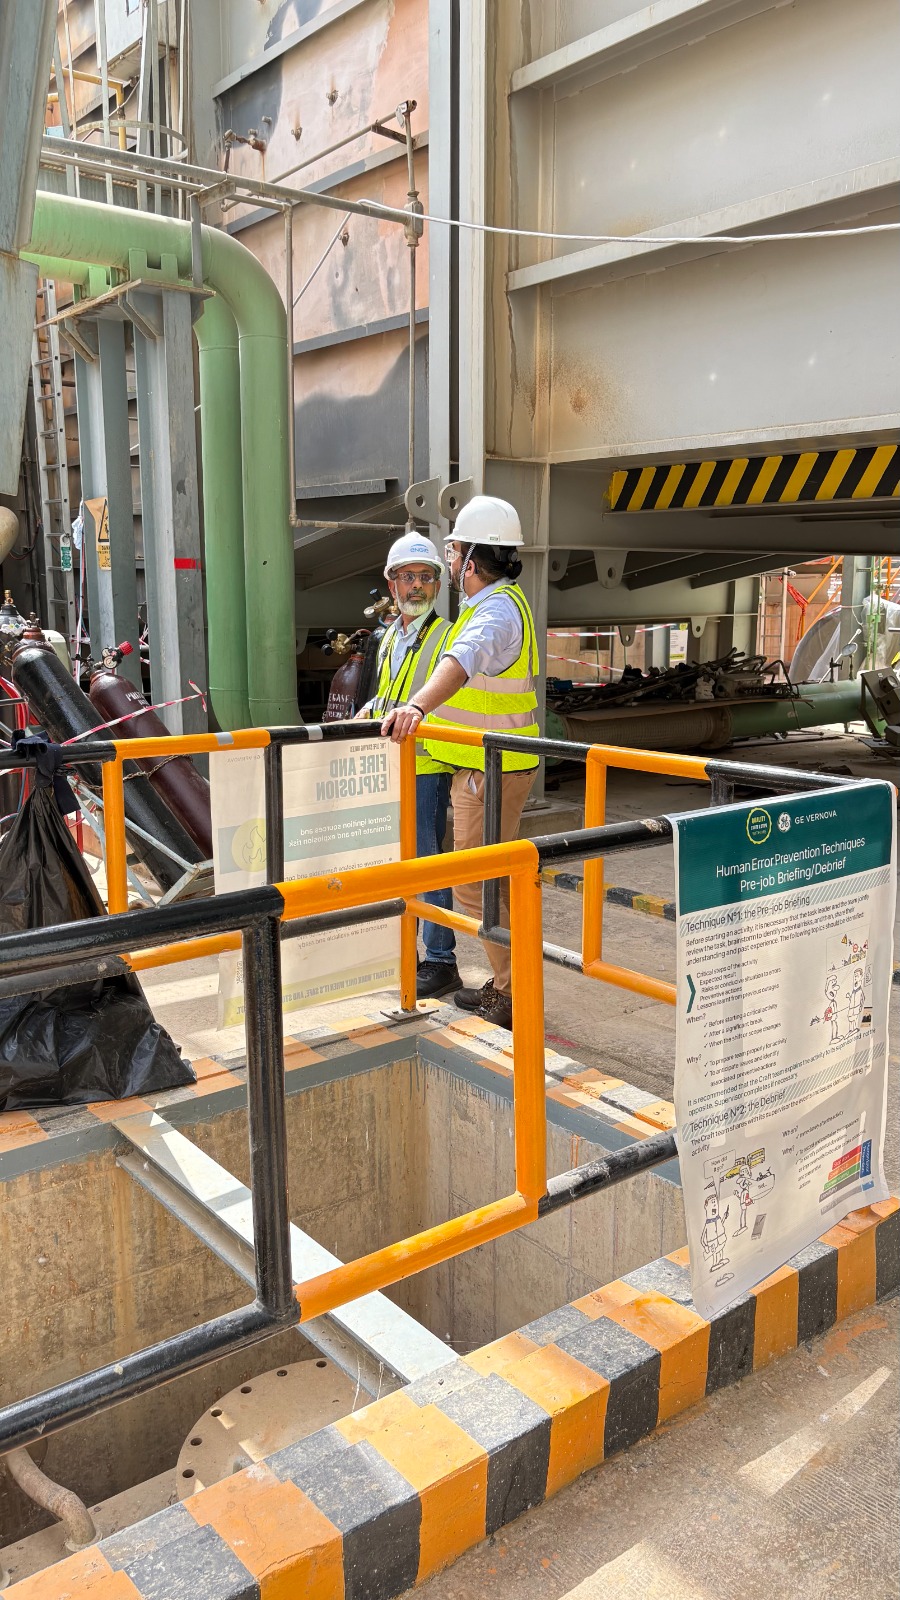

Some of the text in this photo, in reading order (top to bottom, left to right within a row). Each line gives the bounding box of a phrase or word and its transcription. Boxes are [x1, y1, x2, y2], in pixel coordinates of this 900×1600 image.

[794, 815, 804, 825] GE
[806, 809, 837, 822] VERNOVA
[716, 837, 865, 877] Human Error Prevention Techniques
[740, 857, 846, 891] Pre-job Briefing/Debrief
[686, 916, 725, 931] Technique
[744, 909, 755, 918] the
[756, 902, 782, 915] Pre-job
[784, 896, 809, 909] Briefing
[685, 937, 704, 946] Before
[704, 932, 725, 942] starting
[764, 917, 788, 927] necessary
[686, 951, 725, 965] understanding
[737, 945, 749, 954] past
[789, 928, 810, 938] following
[825, 920, 839, 929] should
[727, 935, 756, 946] brainstorm
[699, 974, 722, 985] Expected
[686, 1012, 706, 1023] When?
[708, 1019, 724, 1027] Before
[725, 1013, 742, 1022] starting
[686, 1053, 701, 1063] Why?
[697, 1084, 737, 1102] recommended
[738, 1081, 748, 1089] that
[758, 1073, 771, 1082] Craft
[689, 1112, 728, 1131] Technique
[748, 1101, 759, 1111] the
[760, 1088, 785, 1106] Debrief
[714, 1092, 743, 1106] Supervisor
